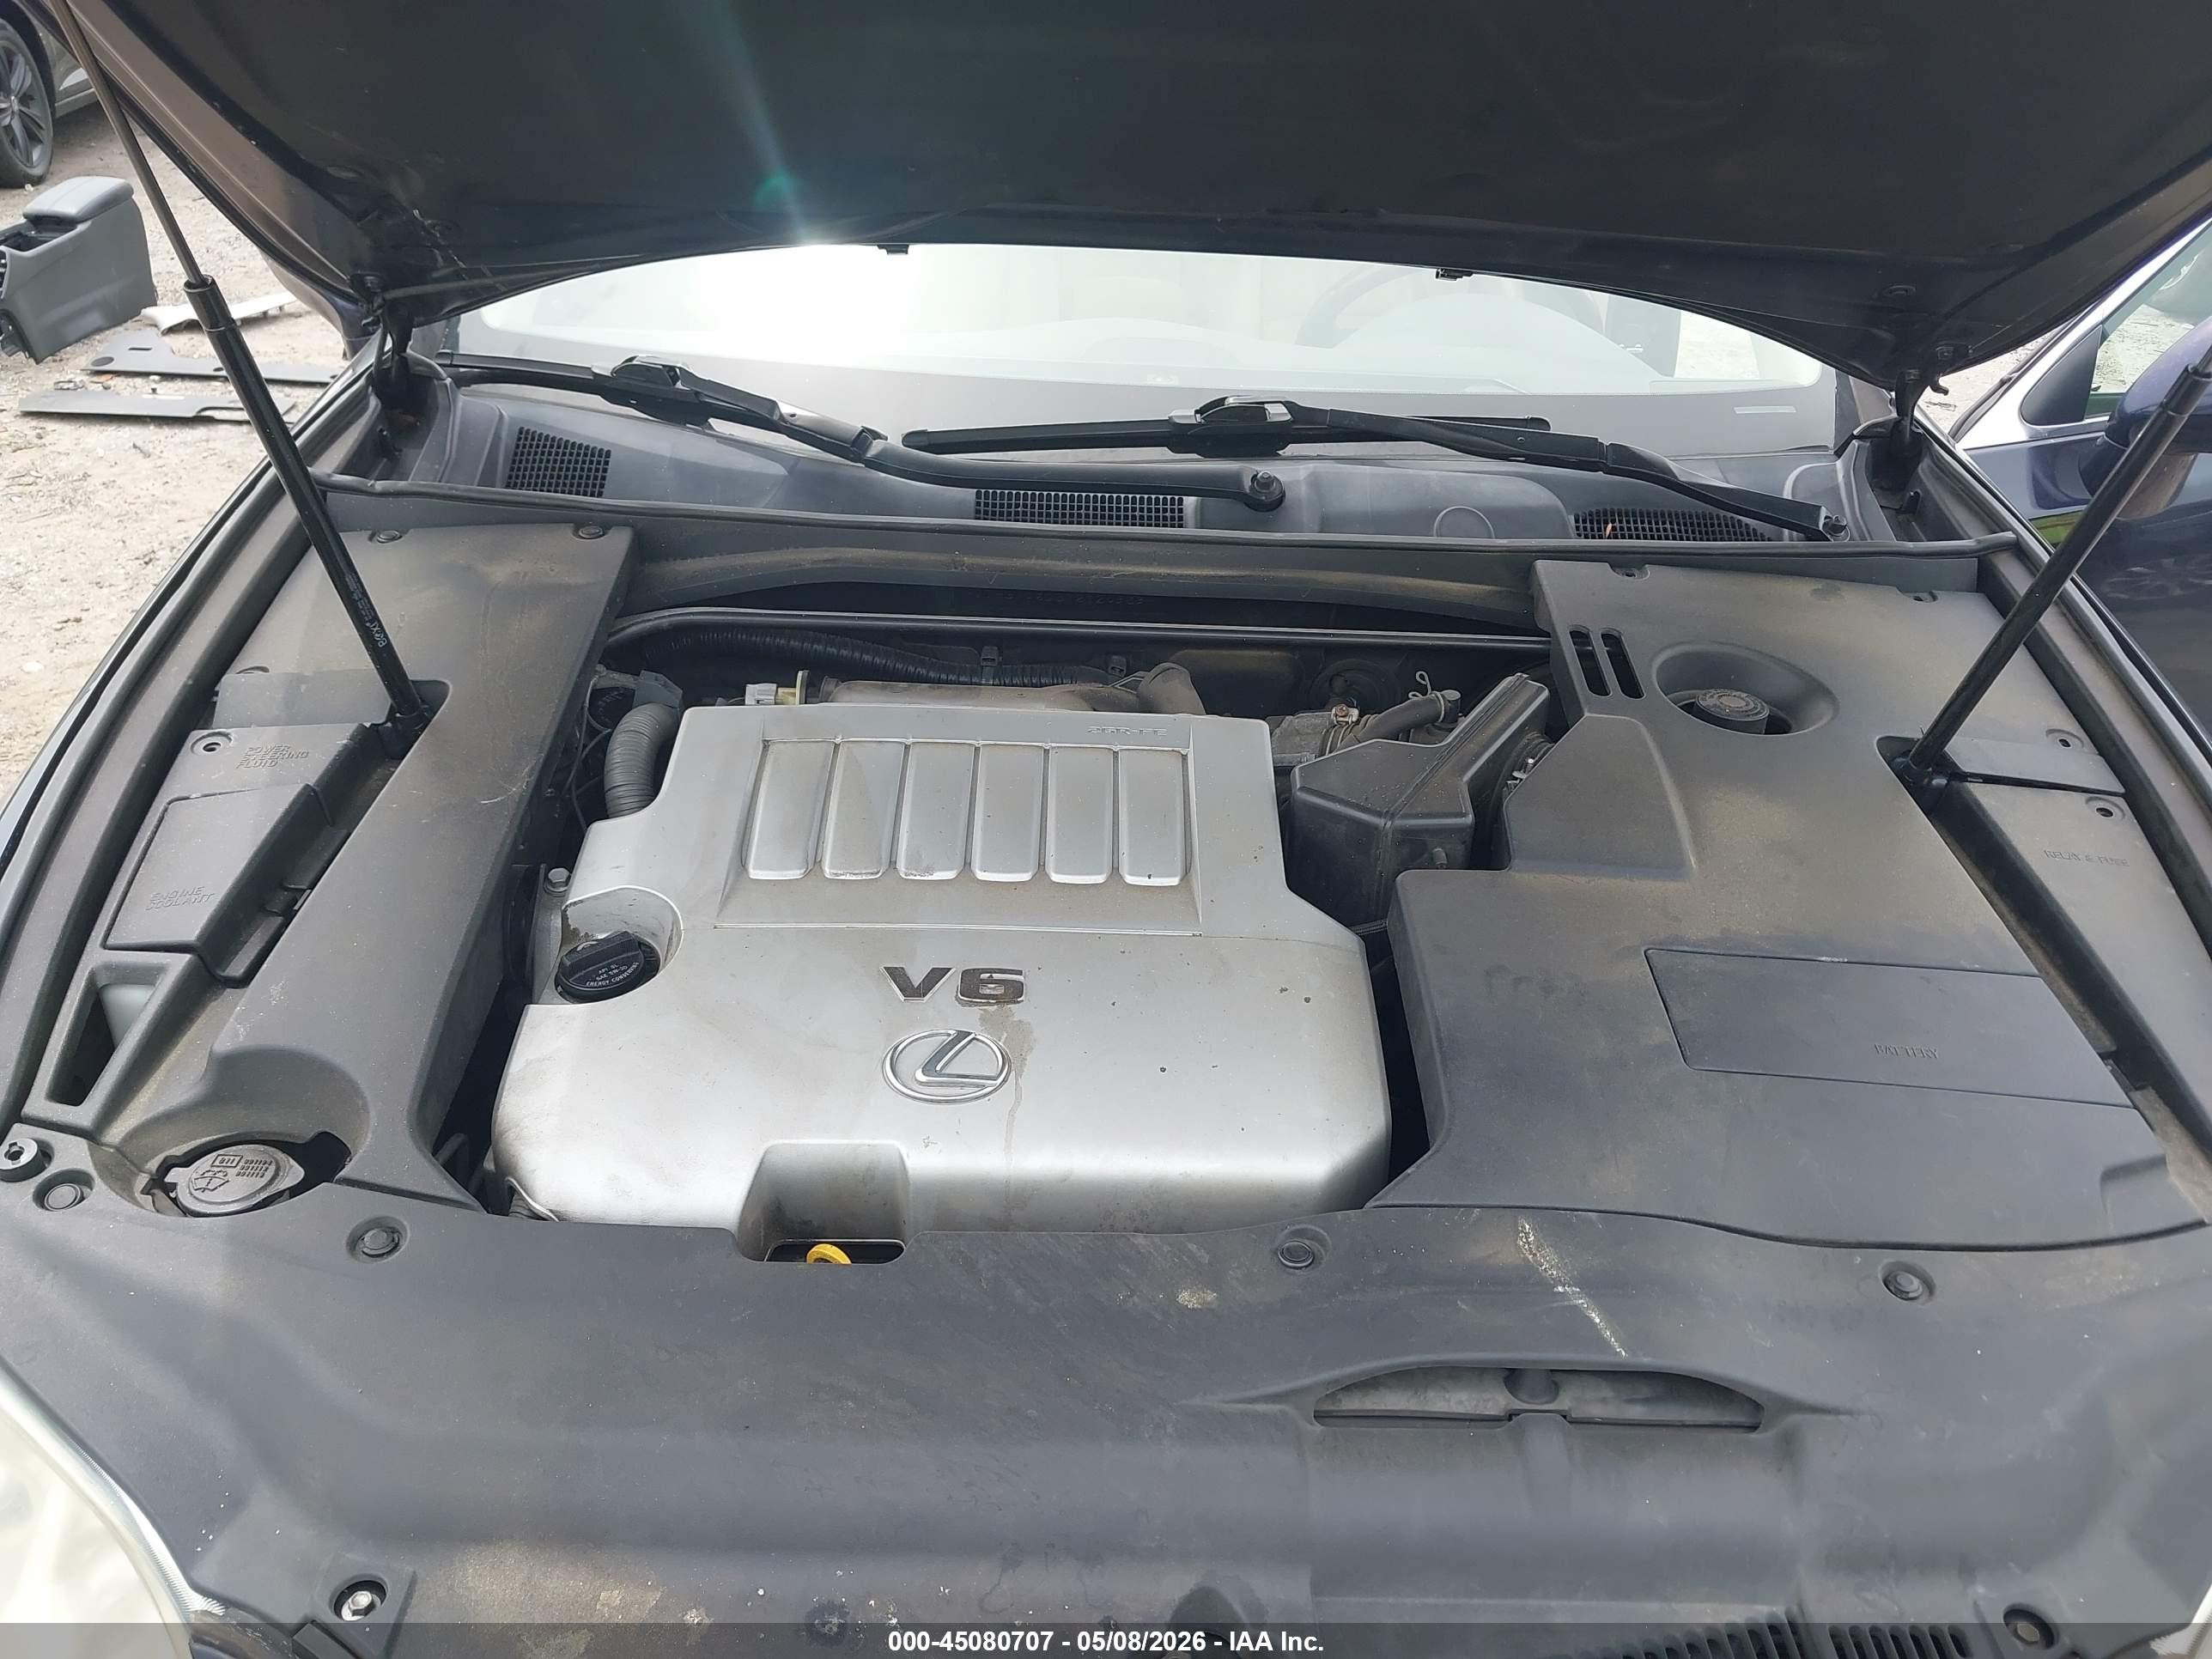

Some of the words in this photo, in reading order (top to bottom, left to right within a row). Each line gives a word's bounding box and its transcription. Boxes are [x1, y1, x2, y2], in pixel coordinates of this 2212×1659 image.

[241, 750, 309, 762] STEERING
[247, 744, 290, 754] POWER
[236, 759, 279, 769] FLUID
[150, 886, 205, 900] ENGINE
[145, 893, 216, 910] COOLANT
[879, 966, 1025, 1006] V6
[1874, 1042, 1939, 1060] BATTERY
